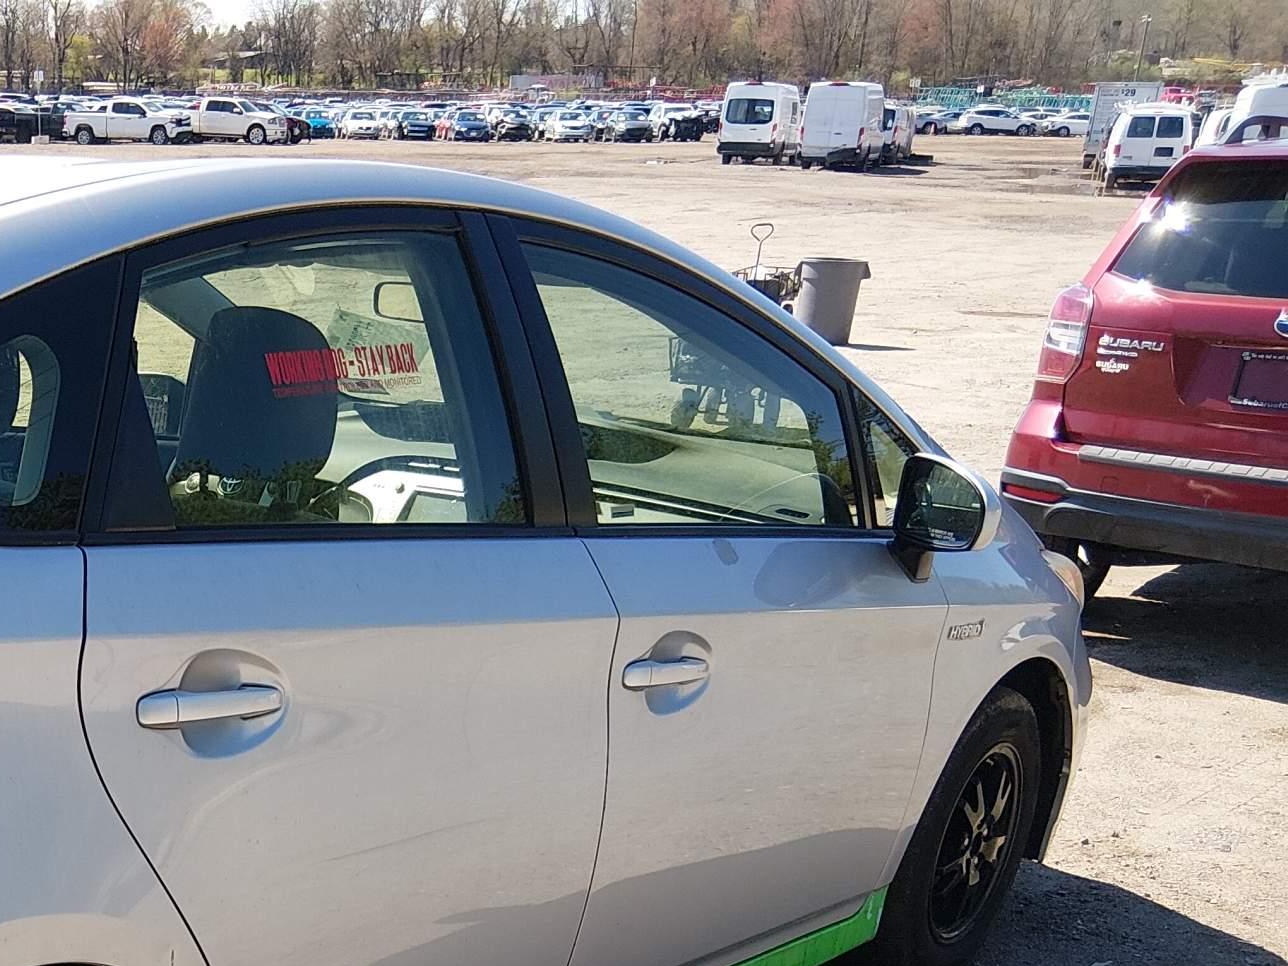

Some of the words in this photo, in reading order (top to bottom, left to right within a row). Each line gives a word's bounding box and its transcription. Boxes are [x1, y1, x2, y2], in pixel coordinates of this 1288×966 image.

[1098, 335, 1165, 351] SUBARU
[264, 349, 325, 385] WORKING
[321, 348, 349, 380] DOG
[354, 345, 388, 377] STAY
[385, 343, 419, 374] BACK
[950, 624, 981, 640] HYBRID
